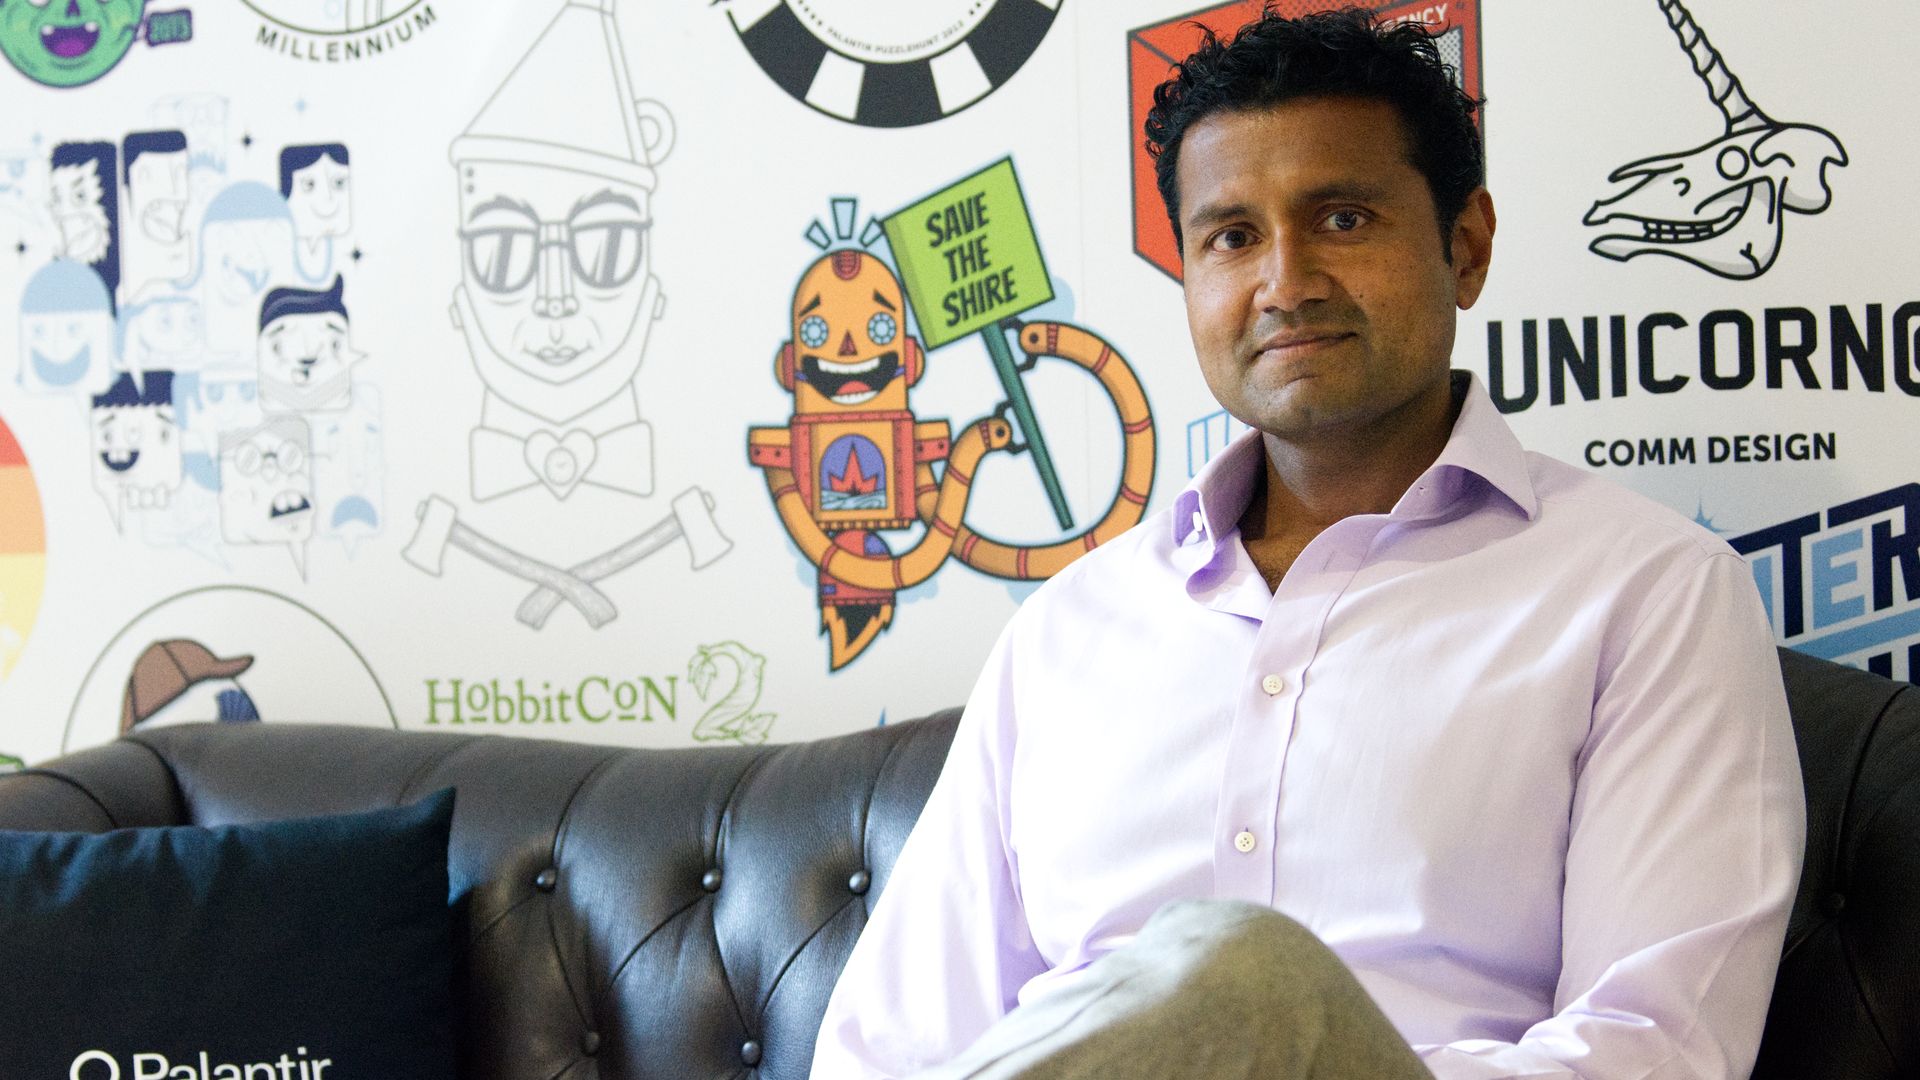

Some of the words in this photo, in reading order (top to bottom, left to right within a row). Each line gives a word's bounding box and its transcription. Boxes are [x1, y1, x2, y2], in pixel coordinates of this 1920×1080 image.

[256, 4, 437, 62] MILLENNIUM
[827, 27, 872, 51] PALANTIR
[875, 35, 938, 54] PUZZLEHUNT
[926, 191, 990, 248] SAVE
[943, 234, 992, 284] THE
[942, 265, 1018, 327] SHIRE
[1584, 437, 1697, 468] COMM
[1707, 432, 1837, 464] DESIGN
[132, 1046, 332, 1080] Palantir
